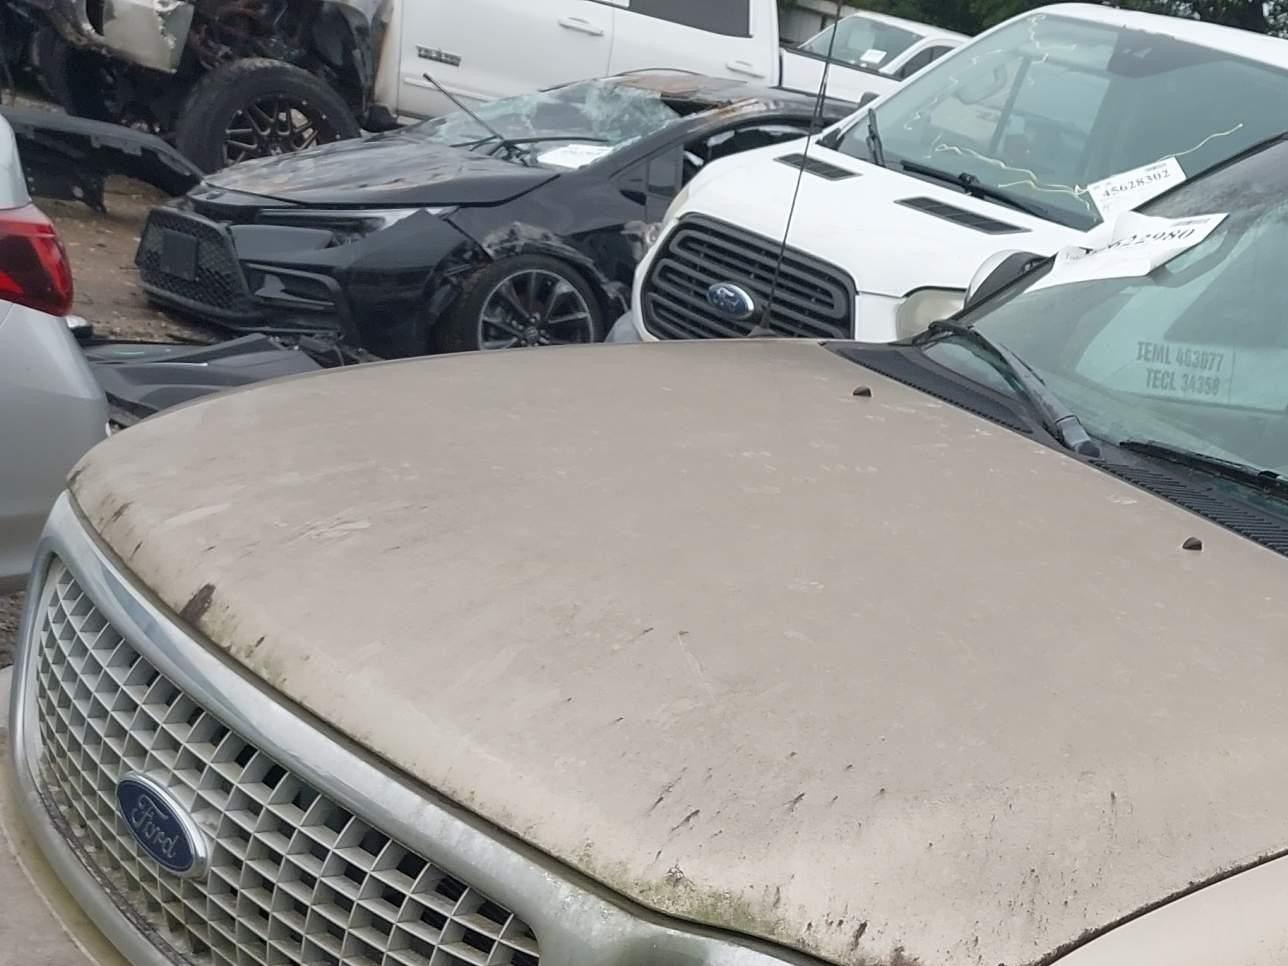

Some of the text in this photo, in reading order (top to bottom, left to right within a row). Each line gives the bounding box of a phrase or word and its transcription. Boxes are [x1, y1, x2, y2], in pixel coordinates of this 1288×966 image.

[1103, 169, 1171, 198] 45628302
[1145, 368, 1176, 391] TECL
[131, 794, 180, 858] Ford
